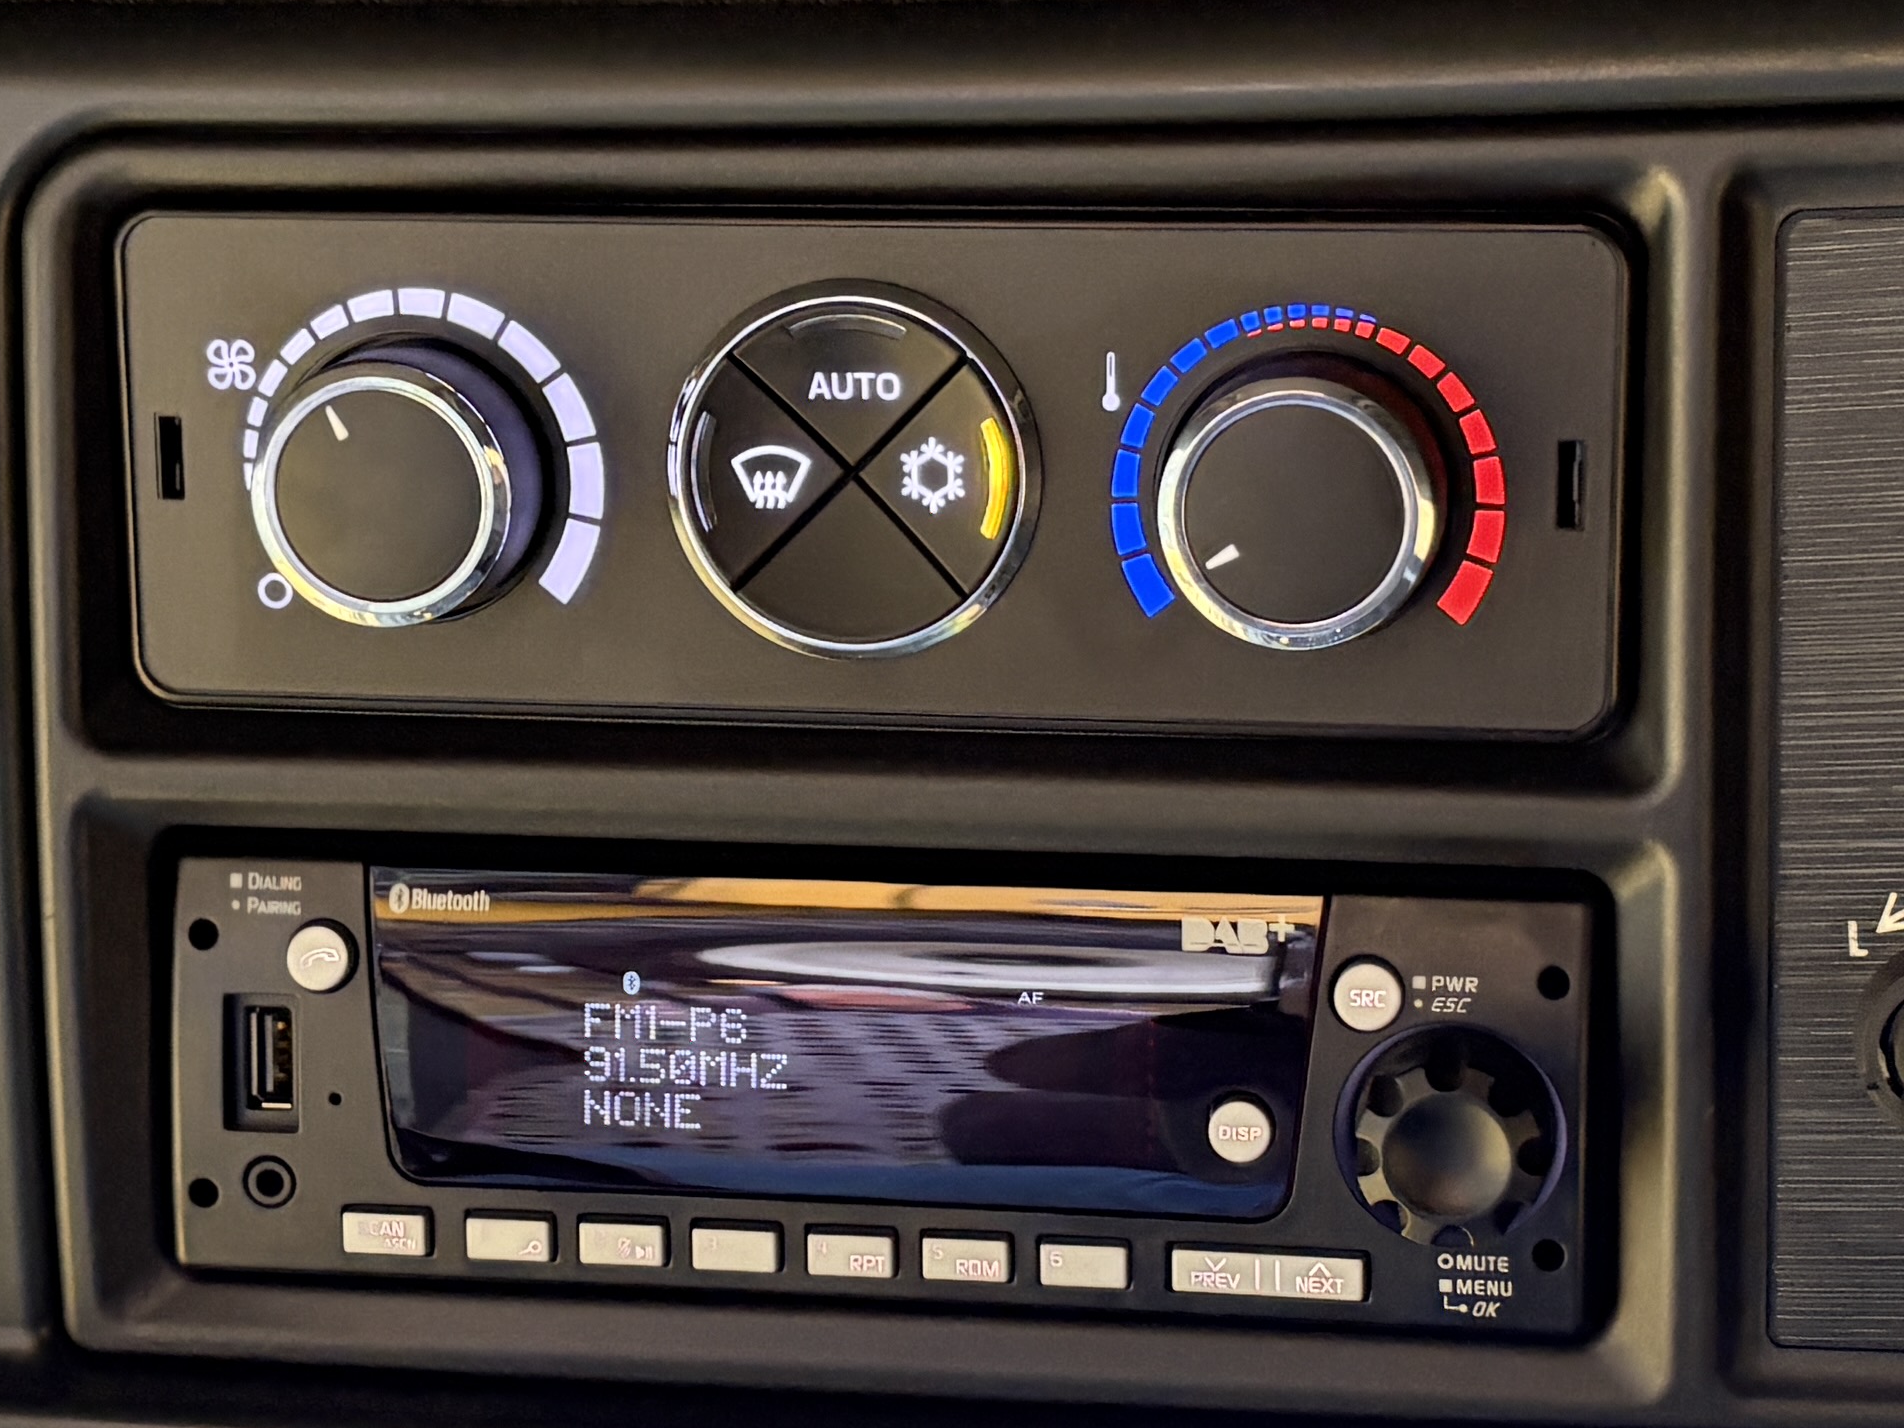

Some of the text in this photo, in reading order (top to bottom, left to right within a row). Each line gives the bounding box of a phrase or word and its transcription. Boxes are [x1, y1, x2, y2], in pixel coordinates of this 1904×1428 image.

[808, 371, 901, 401] AUTO
[247, 872, 302, 891] DIALING
[247, 896, 302, 916] PAIRING
[411, 888, 490, 911] Bluetooth
[1848, 921, 1869, 957] L
[1431, 975, 1479, 993] PWR
[1017, 991, 1044, 1004] AF
[1349, 989, 1387, 1008] SRC
[1431, 997, 1471, 1013] ESC
[584, 1003, 747, 1044] FM1-P6
[584, 1046, 787, 1089] 91.50MHZ
[584, 1089, 701, 1129] NONE
[1218, 1125, 1263, 1141] DISP
[849, 1254, 886, 1274] RPT
[955, 1258, 1001, 1278] RDM
[1456, 1254, 1509, 1273] MUTE
[1190, 1270, 1241, 1290] PREV
[1295, 1275, 1344, 1295] NEXT
[1456, 1278, 1513, 1297] MENU
[1472, 1301, 1501, 1318] OK
